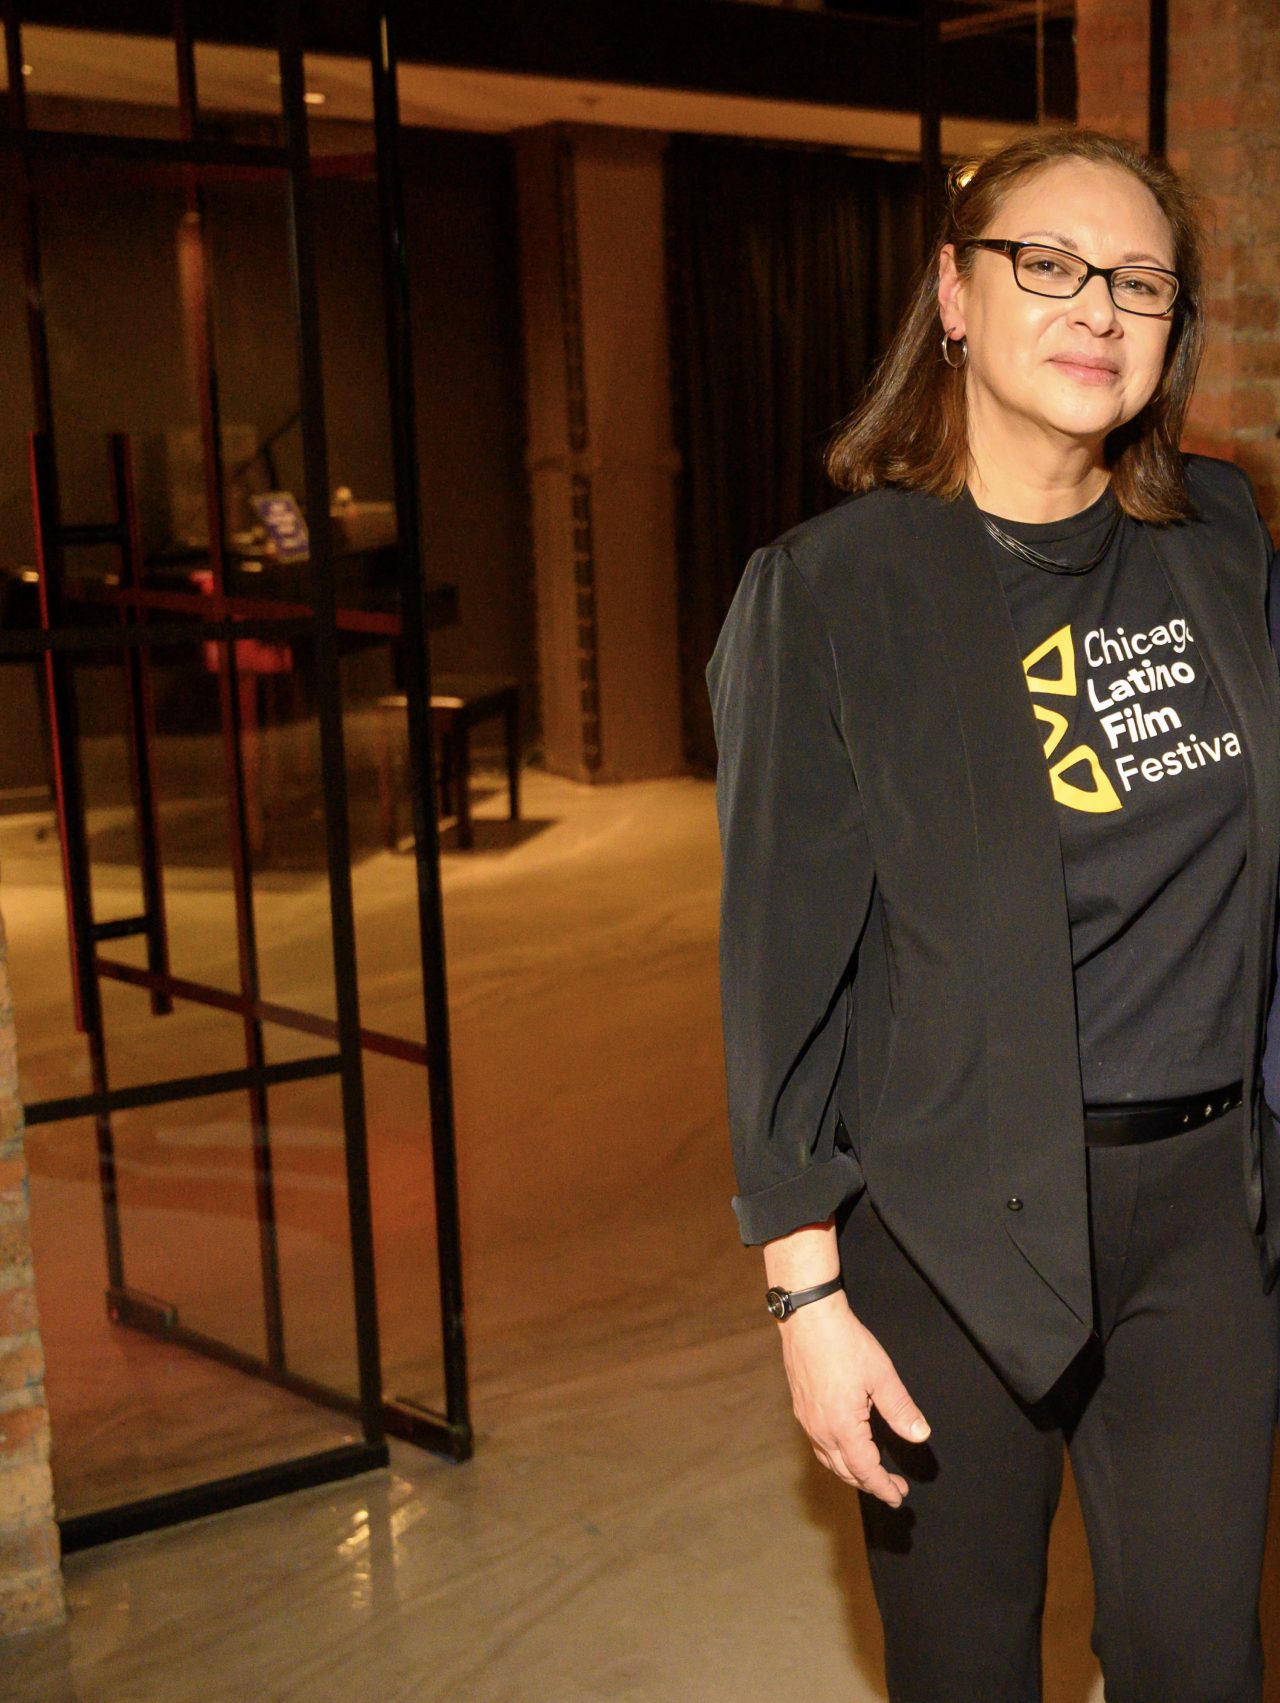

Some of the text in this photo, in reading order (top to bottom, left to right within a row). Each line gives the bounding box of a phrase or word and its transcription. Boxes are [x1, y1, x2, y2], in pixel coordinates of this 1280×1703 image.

[1086, 659, 1196, 712] Latino
[1100, 703, 1183, 749] Film
[1114, 732, 1242, 792] Festiva
